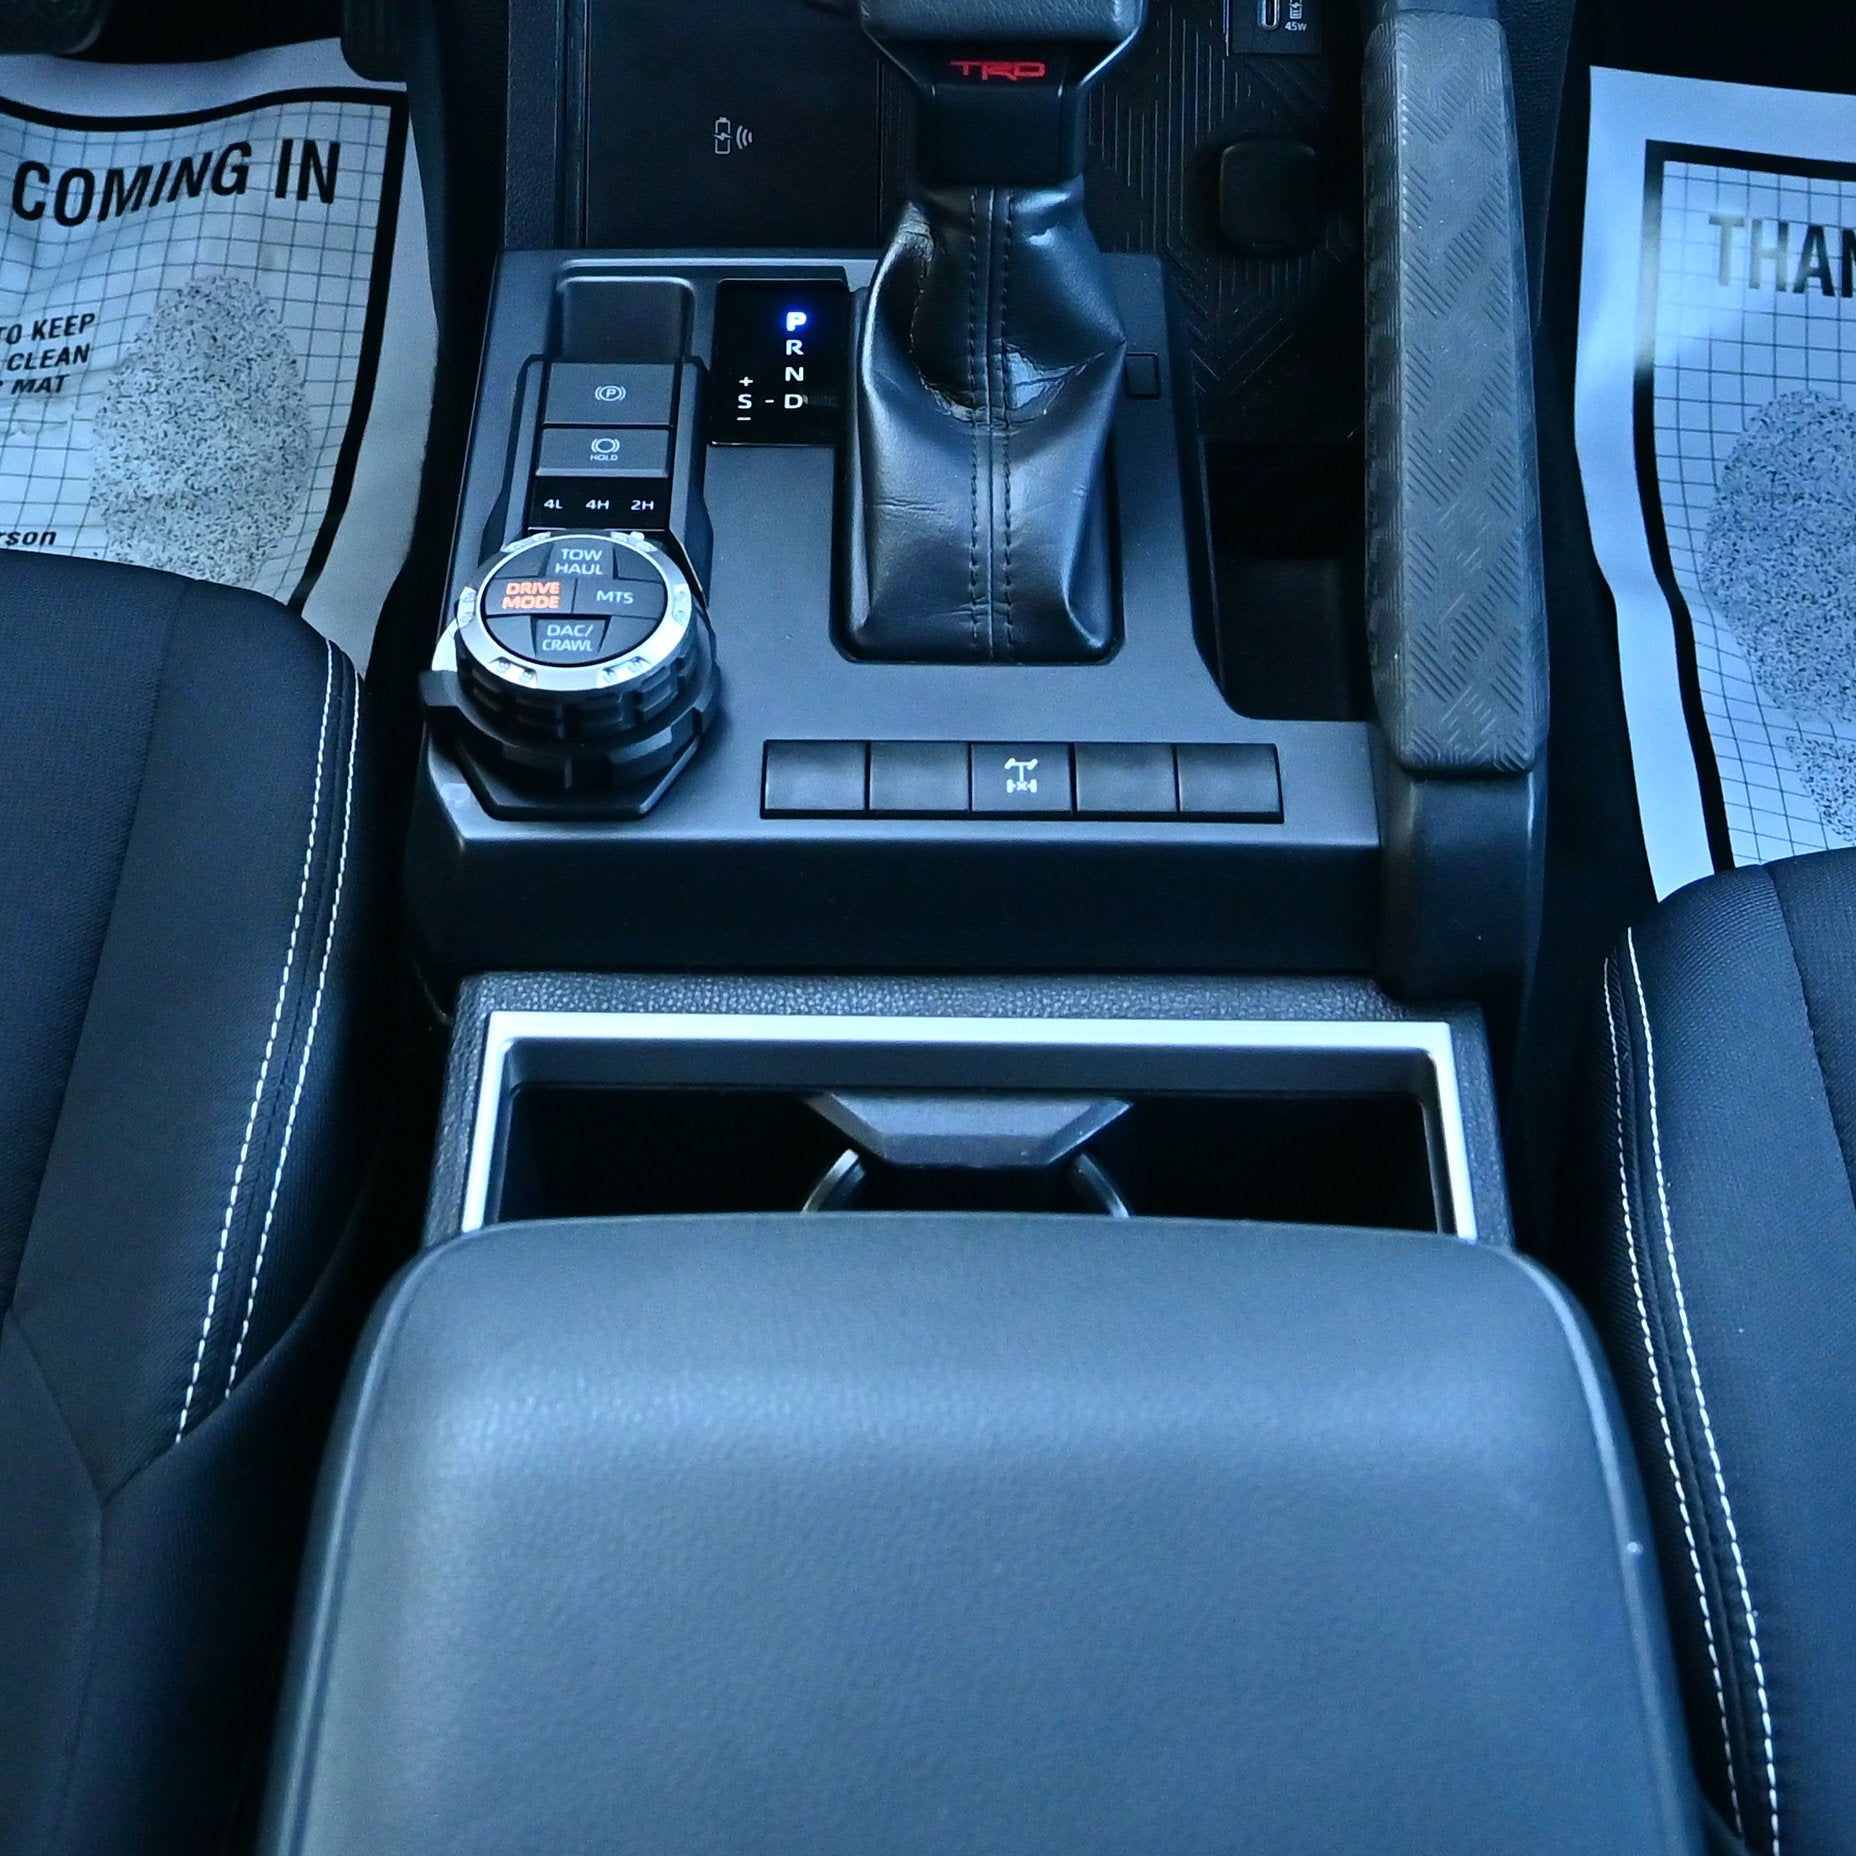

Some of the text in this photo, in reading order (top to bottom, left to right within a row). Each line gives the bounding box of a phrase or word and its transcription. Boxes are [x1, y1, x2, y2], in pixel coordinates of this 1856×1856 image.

[1285, 22, 1307, 31] 45W
[950, 60, 1045, 81] TRD
[12, 141, 252, 227] COMING
[274, 138, 340, 204] IN
[32, 312, 96, 342] KEEP
[786, 312, 807, 332] P
[785, 339, 804, 355] R
[6, 344, 91, 373] CLEAN
[785, 366, 804, 382] N
[11, 374, 71, 397] MAT
[737, 394, 804, 409] S D
[544, 499, 563, 510] 4L
[585, 499, 610, 511] 4H
[630, 499, 654, 511] 2H
[560, 548, 603, 561] TOW
[555, 562, 604, 575] HAUL
[505, 581, 561, 595] DRIVE
[502, 596, 560, 609] MODE
[596, 591, 634, 604] MTS
[546, 624, 592, 637] DAC/
[541, 639, 593, 651] CRAWL
